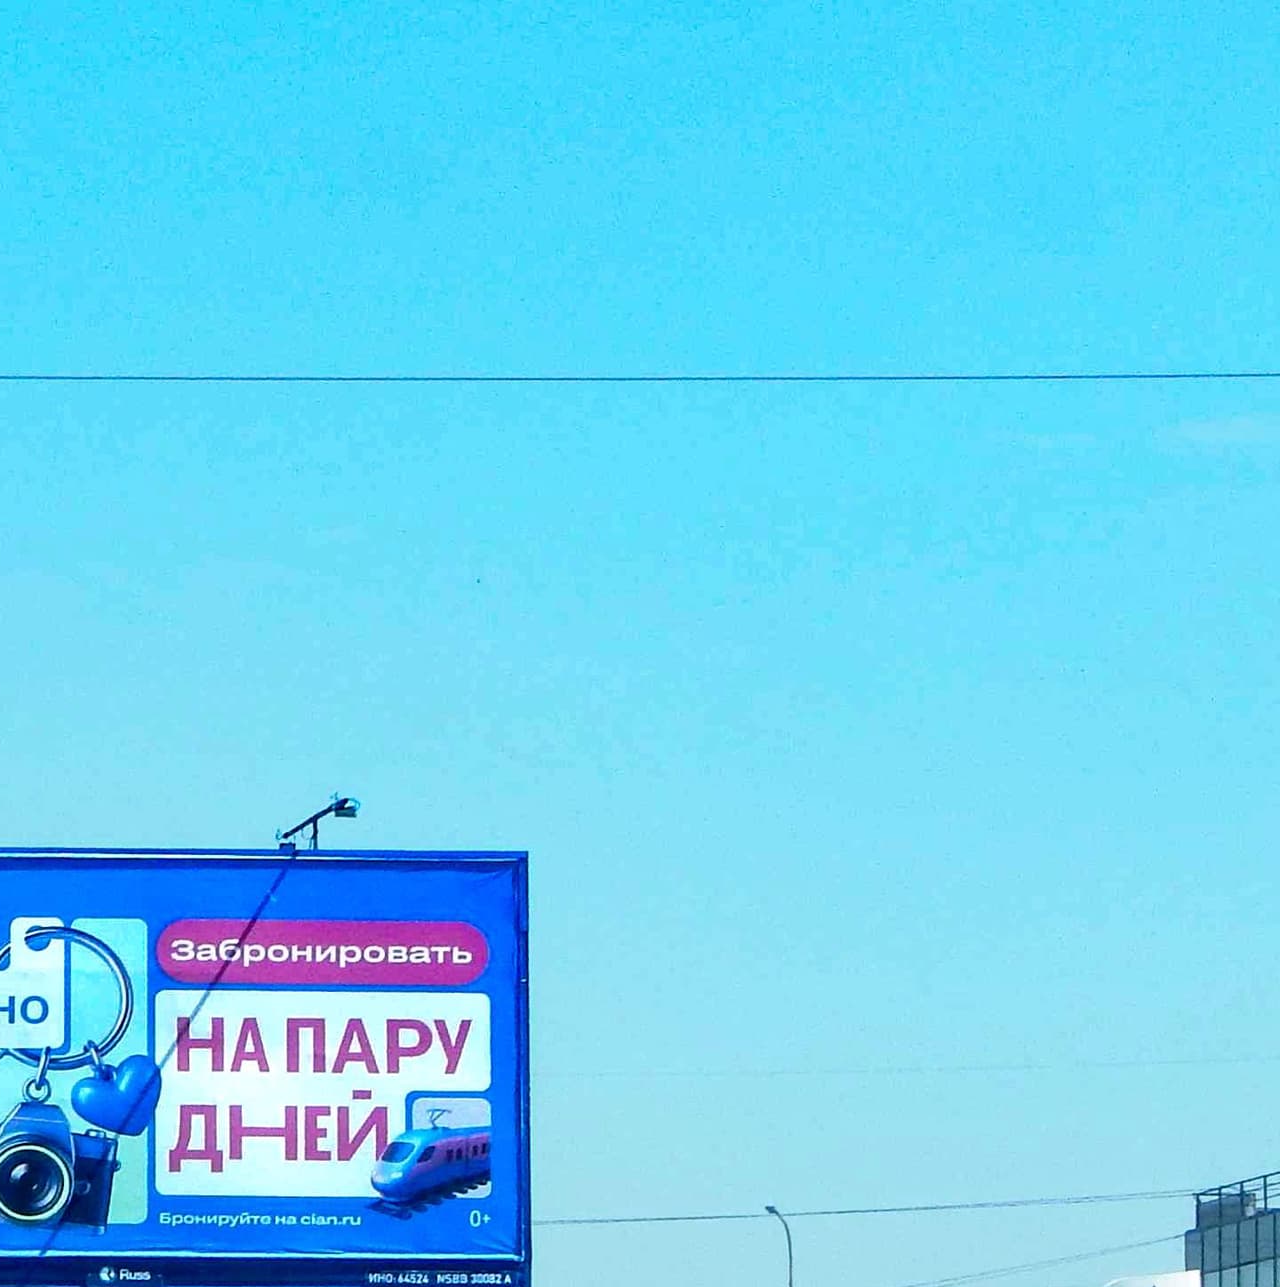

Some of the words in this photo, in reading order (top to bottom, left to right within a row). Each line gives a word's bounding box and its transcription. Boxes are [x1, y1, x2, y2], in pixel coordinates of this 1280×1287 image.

[170, 938, 473, 968] Забронировать
[176, 1016, 271, 1073] НА
[285, 1017, 473, 1075] ПАРУ
[168, 1089, 389, 1173] ДНЕЙ
[159, 1212, 272, 1227] Бронируйте
[274, 1215, 298, 1226] на
[300, 1213, 362, 1227] cian.ru
[469, 1209, 492, 1228] 0+
[119, 1268, 152, 1281] Russ
